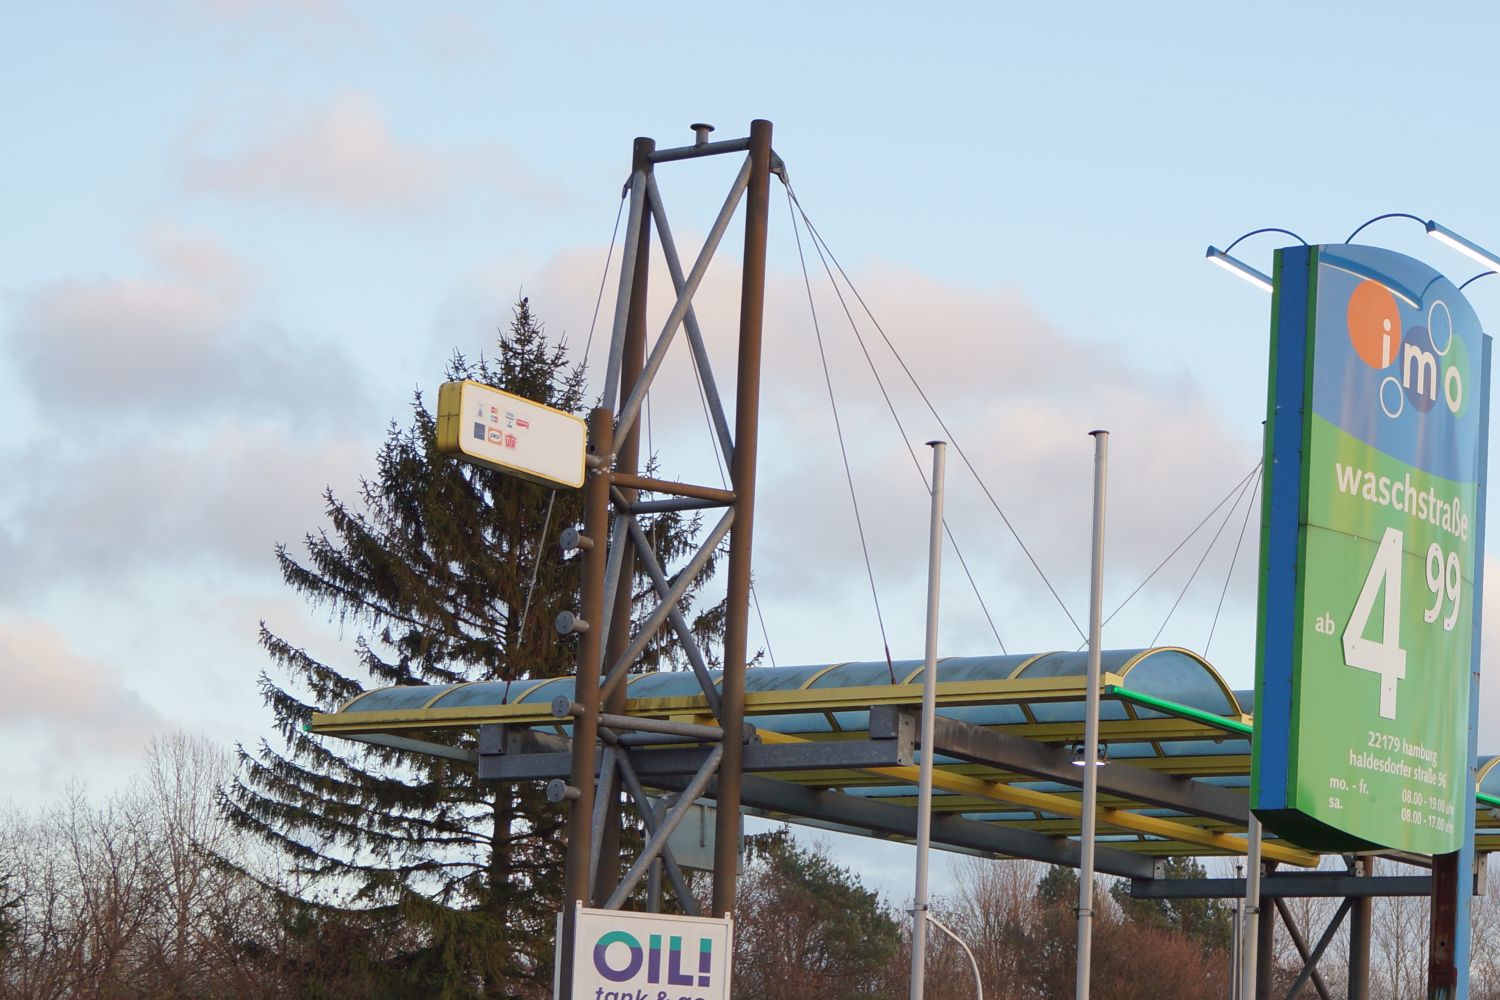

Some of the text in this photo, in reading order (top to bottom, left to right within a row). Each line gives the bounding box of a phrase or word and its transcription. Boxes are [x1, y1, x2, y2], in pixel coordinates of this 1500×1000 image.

[1381, 318, 1462, 413] imo
[1335, 463, 1469, 542] waschstraße
[1315, 612, 1335, 636] ab
[1342, 526, 1462, 720] 4 99
[1349, 749, 1447, 788] haldesdorfer straße 96
[1368, 731, 1438, 768] 22179 hamburg
[1328, 797, 1343, 809] sa.
[1401, 808, 1422, 824] 08.00
[1428, 815, 1444, 830] 17.00
[1329, 777, 1349, 791] mo.
[1359, 779, 1369, 794] fr.
[1401, 789, 1423, 806] 08.00
[1428, 796, 1445, 812] 19.00
[593, 930, 713, 988] OIL!
